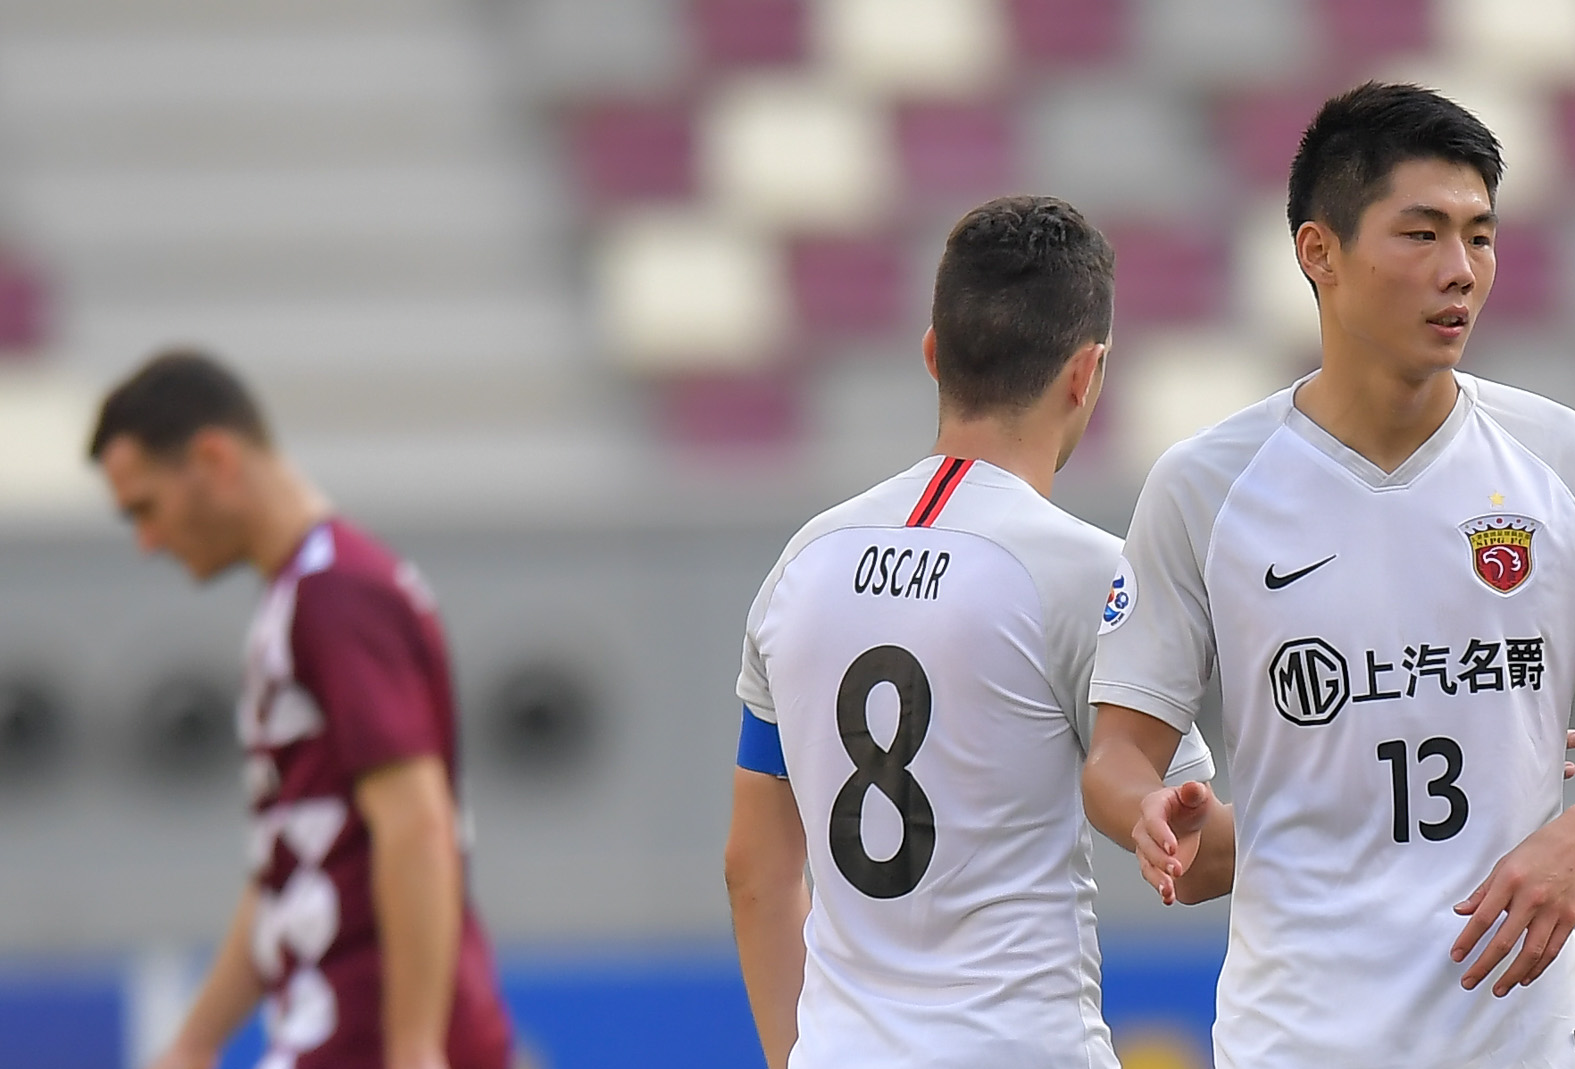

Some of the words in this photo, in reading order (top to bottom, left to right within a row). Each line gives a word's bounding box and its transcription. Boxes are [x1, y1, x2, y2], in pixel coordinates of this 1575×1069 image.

[854, 545, 951, 600] OSCAR
[1352, 637, 1545, 702] 上汽名爵
[829, 644, 936, 899] 8
[1377, 737, 1469, 843] 13
